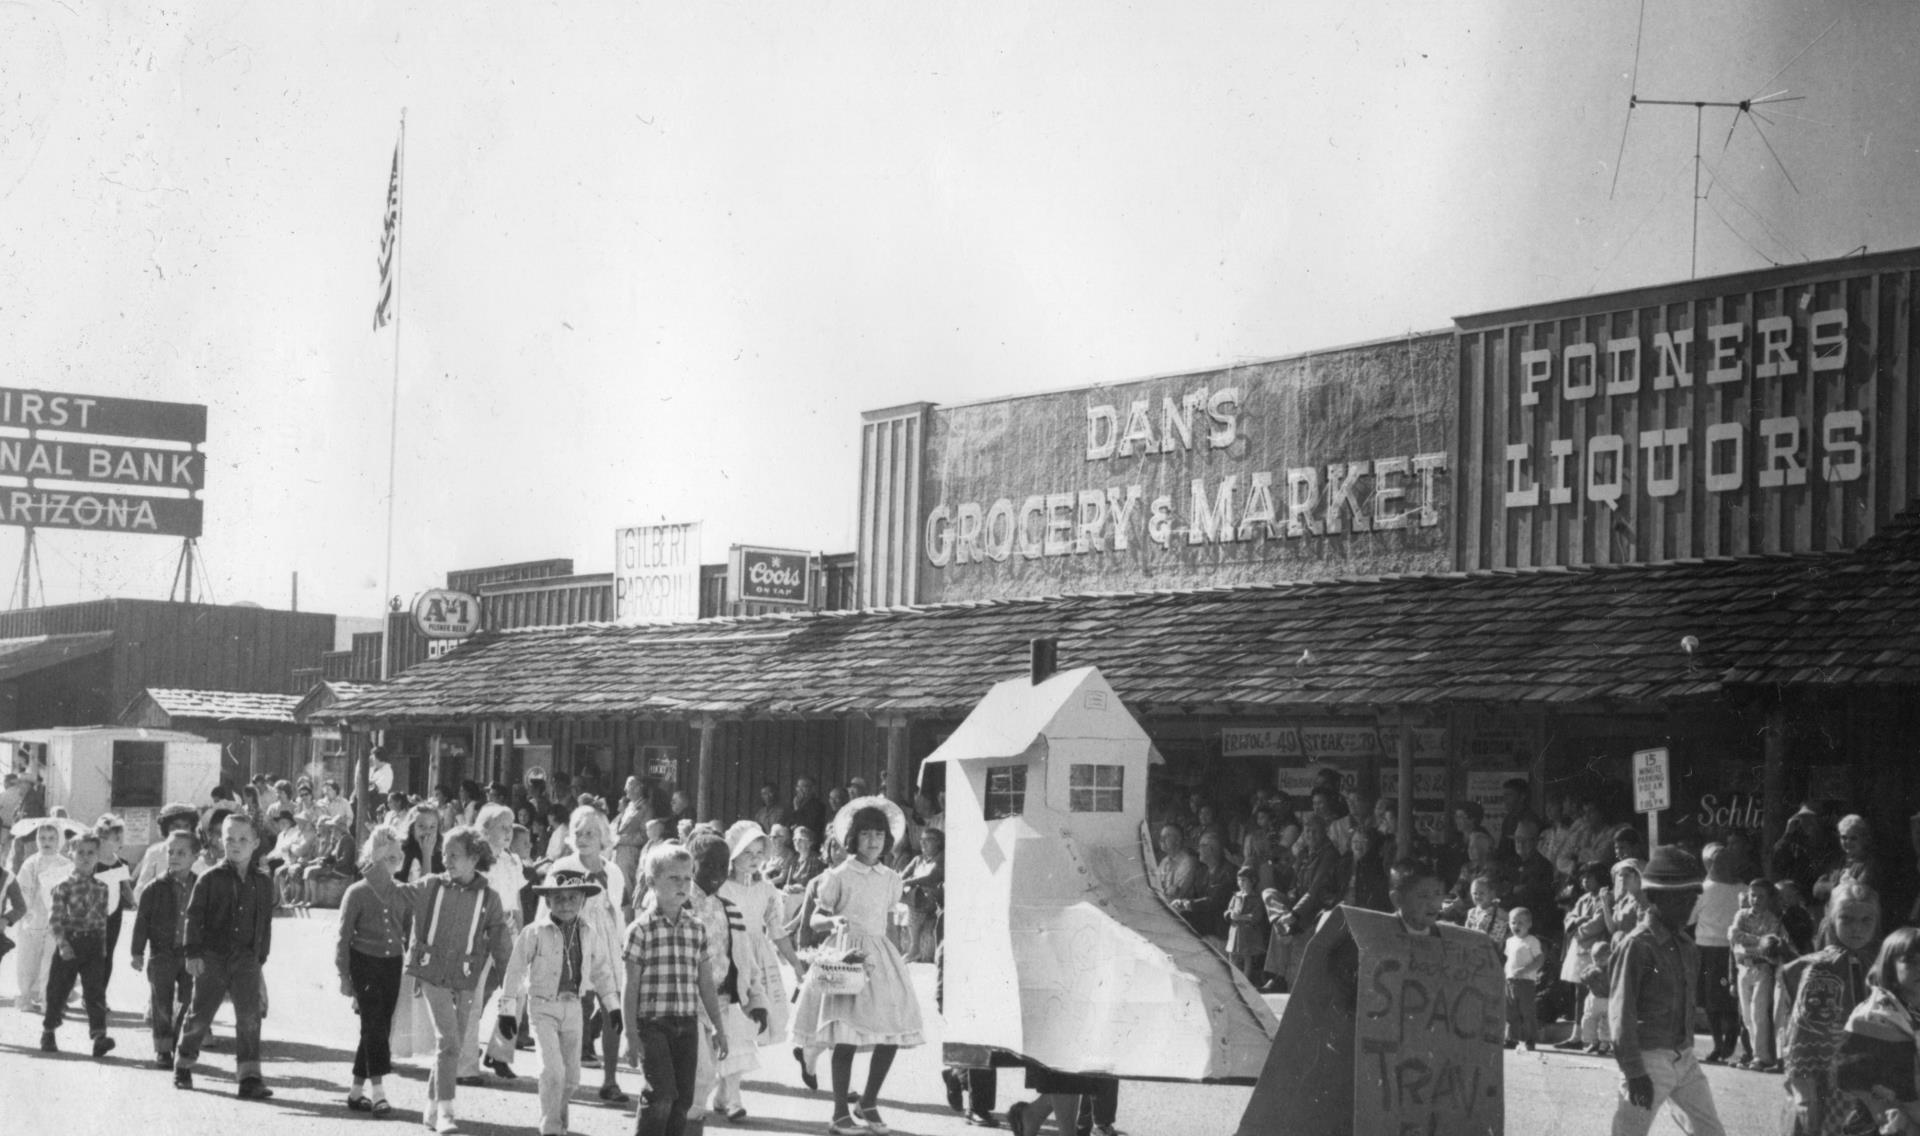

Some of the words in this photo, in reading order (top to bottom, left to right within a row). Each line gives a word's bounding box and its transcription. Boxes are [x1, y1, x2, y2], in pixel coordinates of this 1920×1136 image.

[1520, 308, 1849, 406] PODNERS
[1086, 386, 1240, 461] DAN'S
[0, 440, 73, 477] NAL
[88, 448, 194, 486] BANK
[1504, 409, 1864, 512] LIQUORS
[0, 491, 157, 530] RIZONA
[925, 484, 1142, 568] GROCERY
[1149, 494, 1173, 549] &
[1188, 451, 1448, 546] MARKET
[624, 523, 692, 569] GILBERT
[749, 561, 802, 587] Coors
[755, 586, 770, 594] ON
[423, 598, 470, 623] A-1
[1304, 733, 1345, 753] STEAK
[1644, 753, 1657, 766] 15
[1637, 772, 1665, 785] PARKING
[1366, 958, 1501, 1046] SPACE
